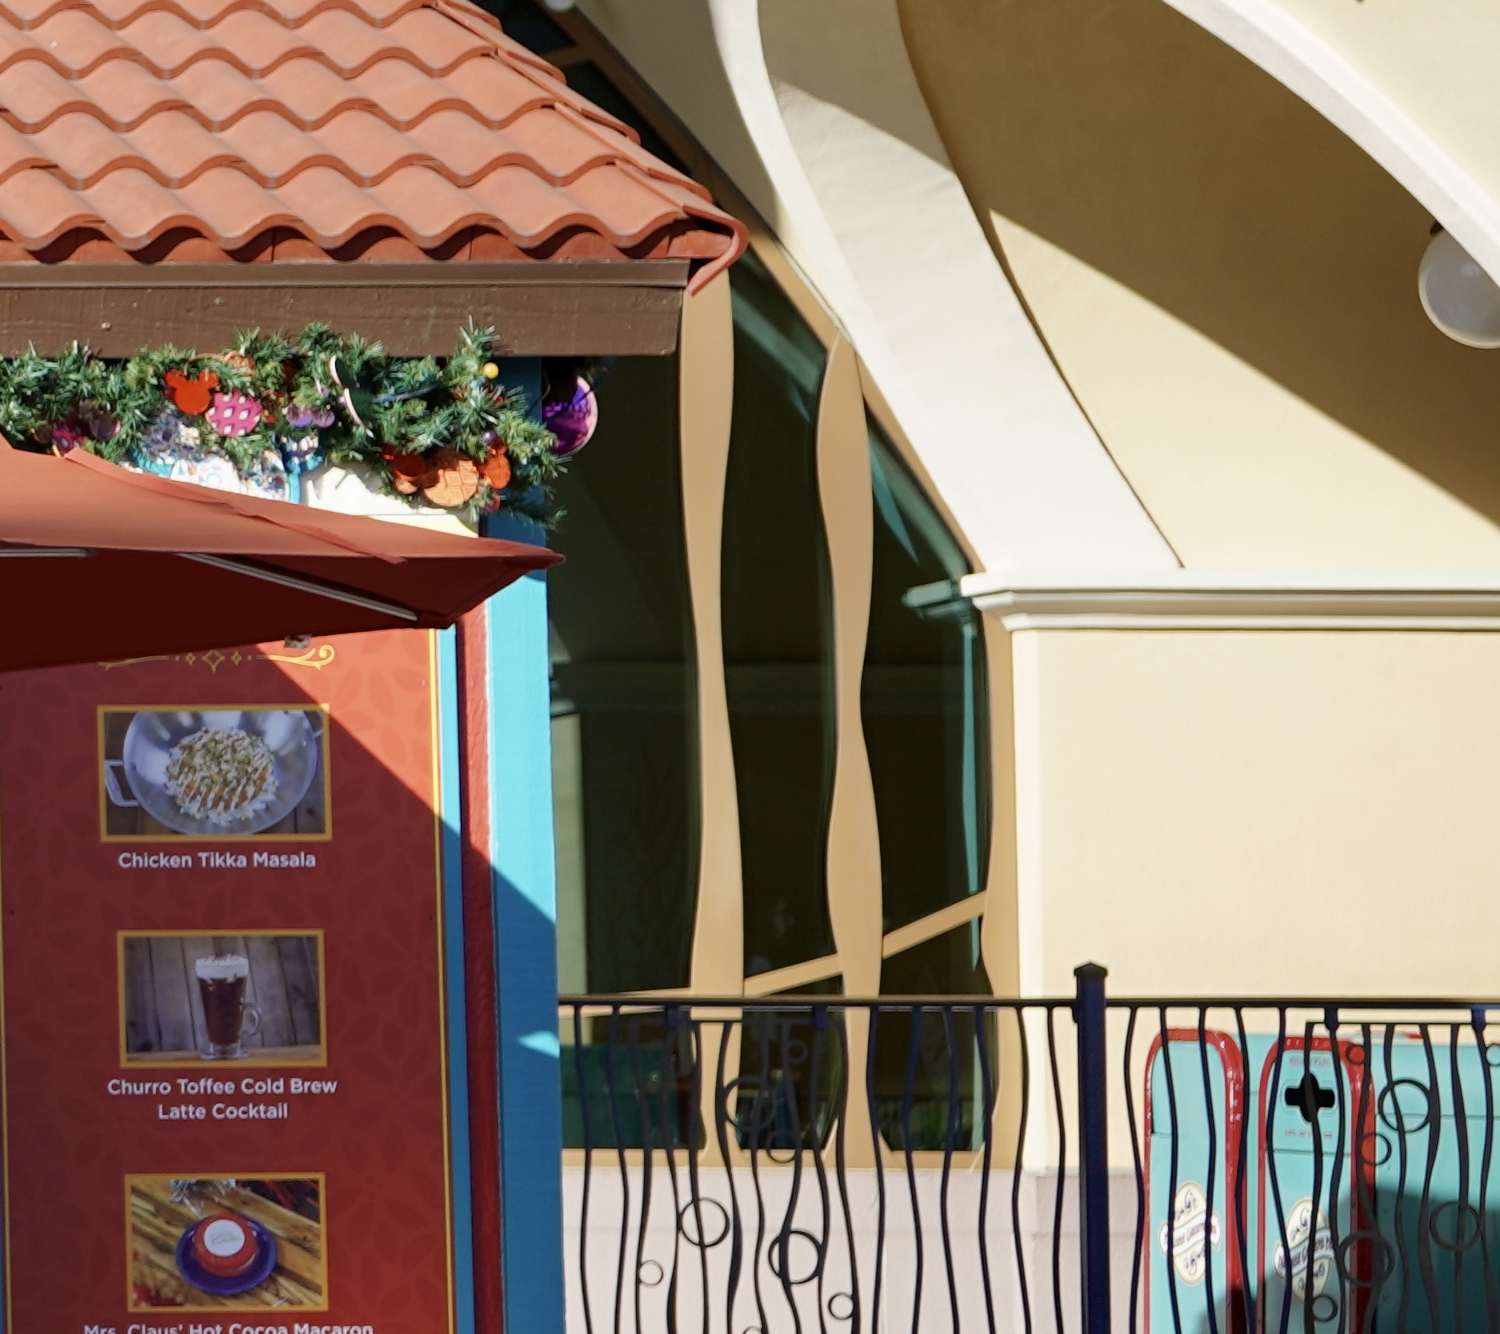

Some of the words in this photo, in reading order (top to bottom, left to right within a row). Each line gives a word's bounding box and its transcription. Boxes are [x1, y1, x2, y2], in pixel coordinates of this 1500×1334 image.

[118, 853, 192, 868] Chicken
[198, 852, 246, 867] Tikka
[253, 852, 316, 867] Masala
[108, 1079, 171, 1095] Churro
[177, 1079, 235, 1094] Toffee
[241, 1078, 284, 1094] Cold
[290, 1078, 337, 1093] Brew
[159, 1105, 206, 1119] Latte
[212, 1103, 287, 1119] Cocktail
